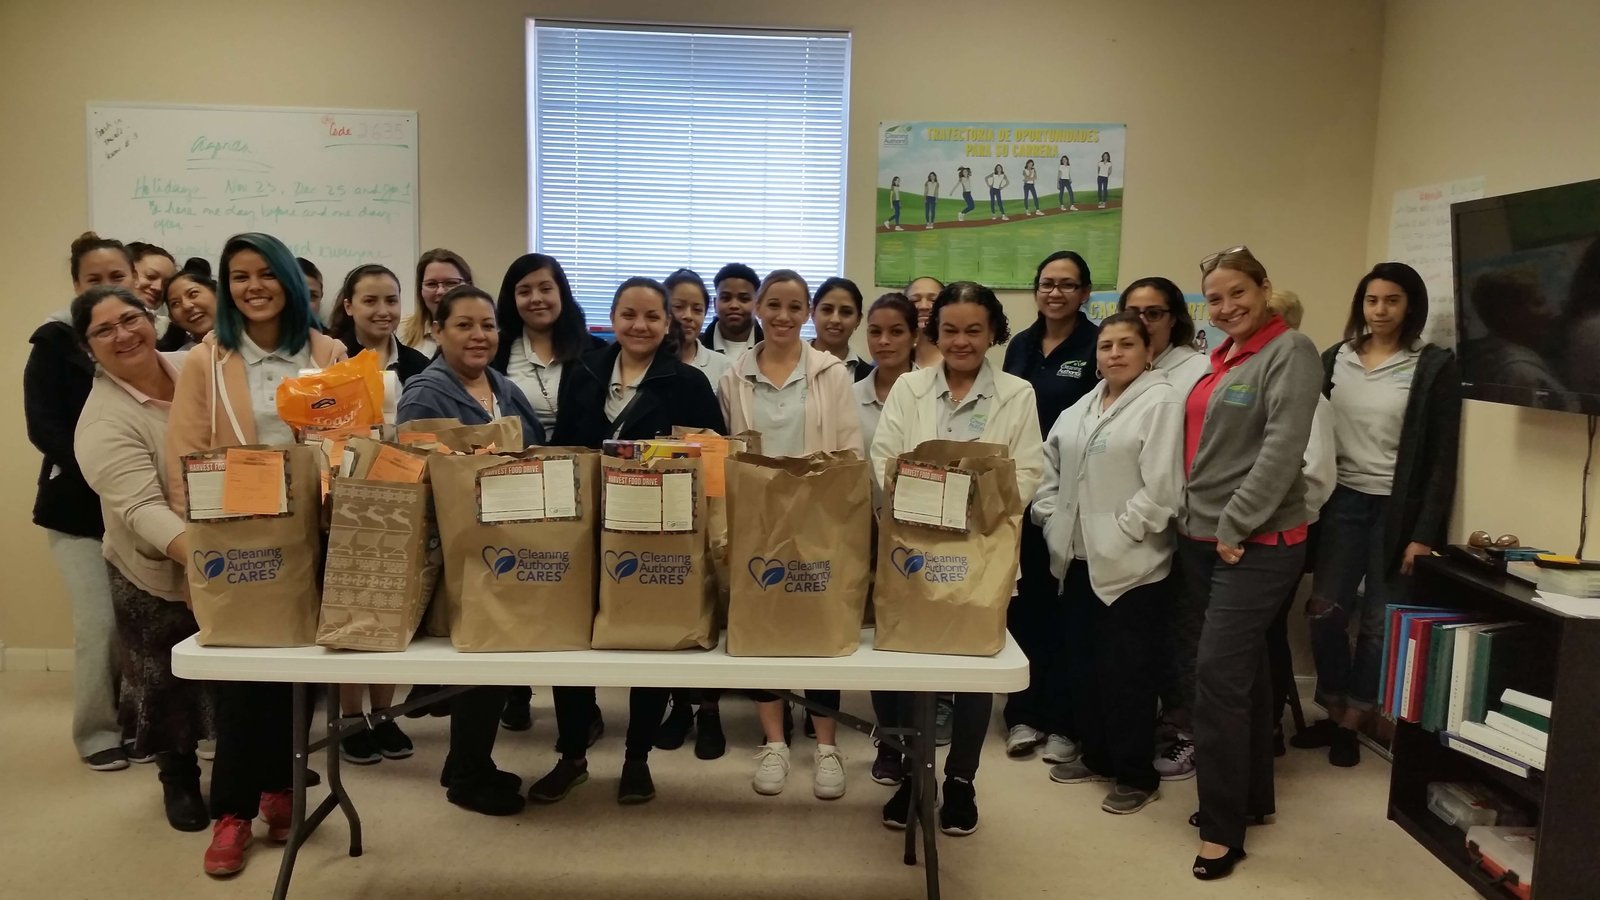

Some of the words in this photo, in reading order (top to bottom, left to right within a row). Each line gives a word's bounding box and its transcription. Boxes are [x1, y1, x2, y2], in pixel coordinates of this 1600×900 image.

[329, 122, 353, 137] Code
[927, 126, 994, 142] TRAYECTORIA
[997, 127, 1012, 142] DE
[1014, 127, 1100, 143] OPORTUNIDADES
[965, 143, 992, 158] PARA
[995, 144, 1009, 158] SU
[1012, 144, 1059, 158] CARRERA
[189, 462, 214, 472] HARVEST
[214, 461, 226, 471] FOO
[508, 466, 523, 474] FOOD
[523, 464, 539, 473] DRIVE
[608, 475, 628, 484] HARVEST
[628, 477, 642, 485] FOOD
[642, 478, 659, 486] DRIVE
[226, 547, 282, 561] Cleaning
[517, 548, 570, 562] Cleaning
[640, 551, 692, 566] Cleaning
[925, 551, 968, 566] Cleaning
[787, 560, 831, 571] Cleaning
[226, 568, 277, 585] CARES
[516, 571, 562, 582] CARES
[639, 574, 684, 585] CARES
[924, 572, 965, 583] CARES
[784, 581, 827, 593] CARES
